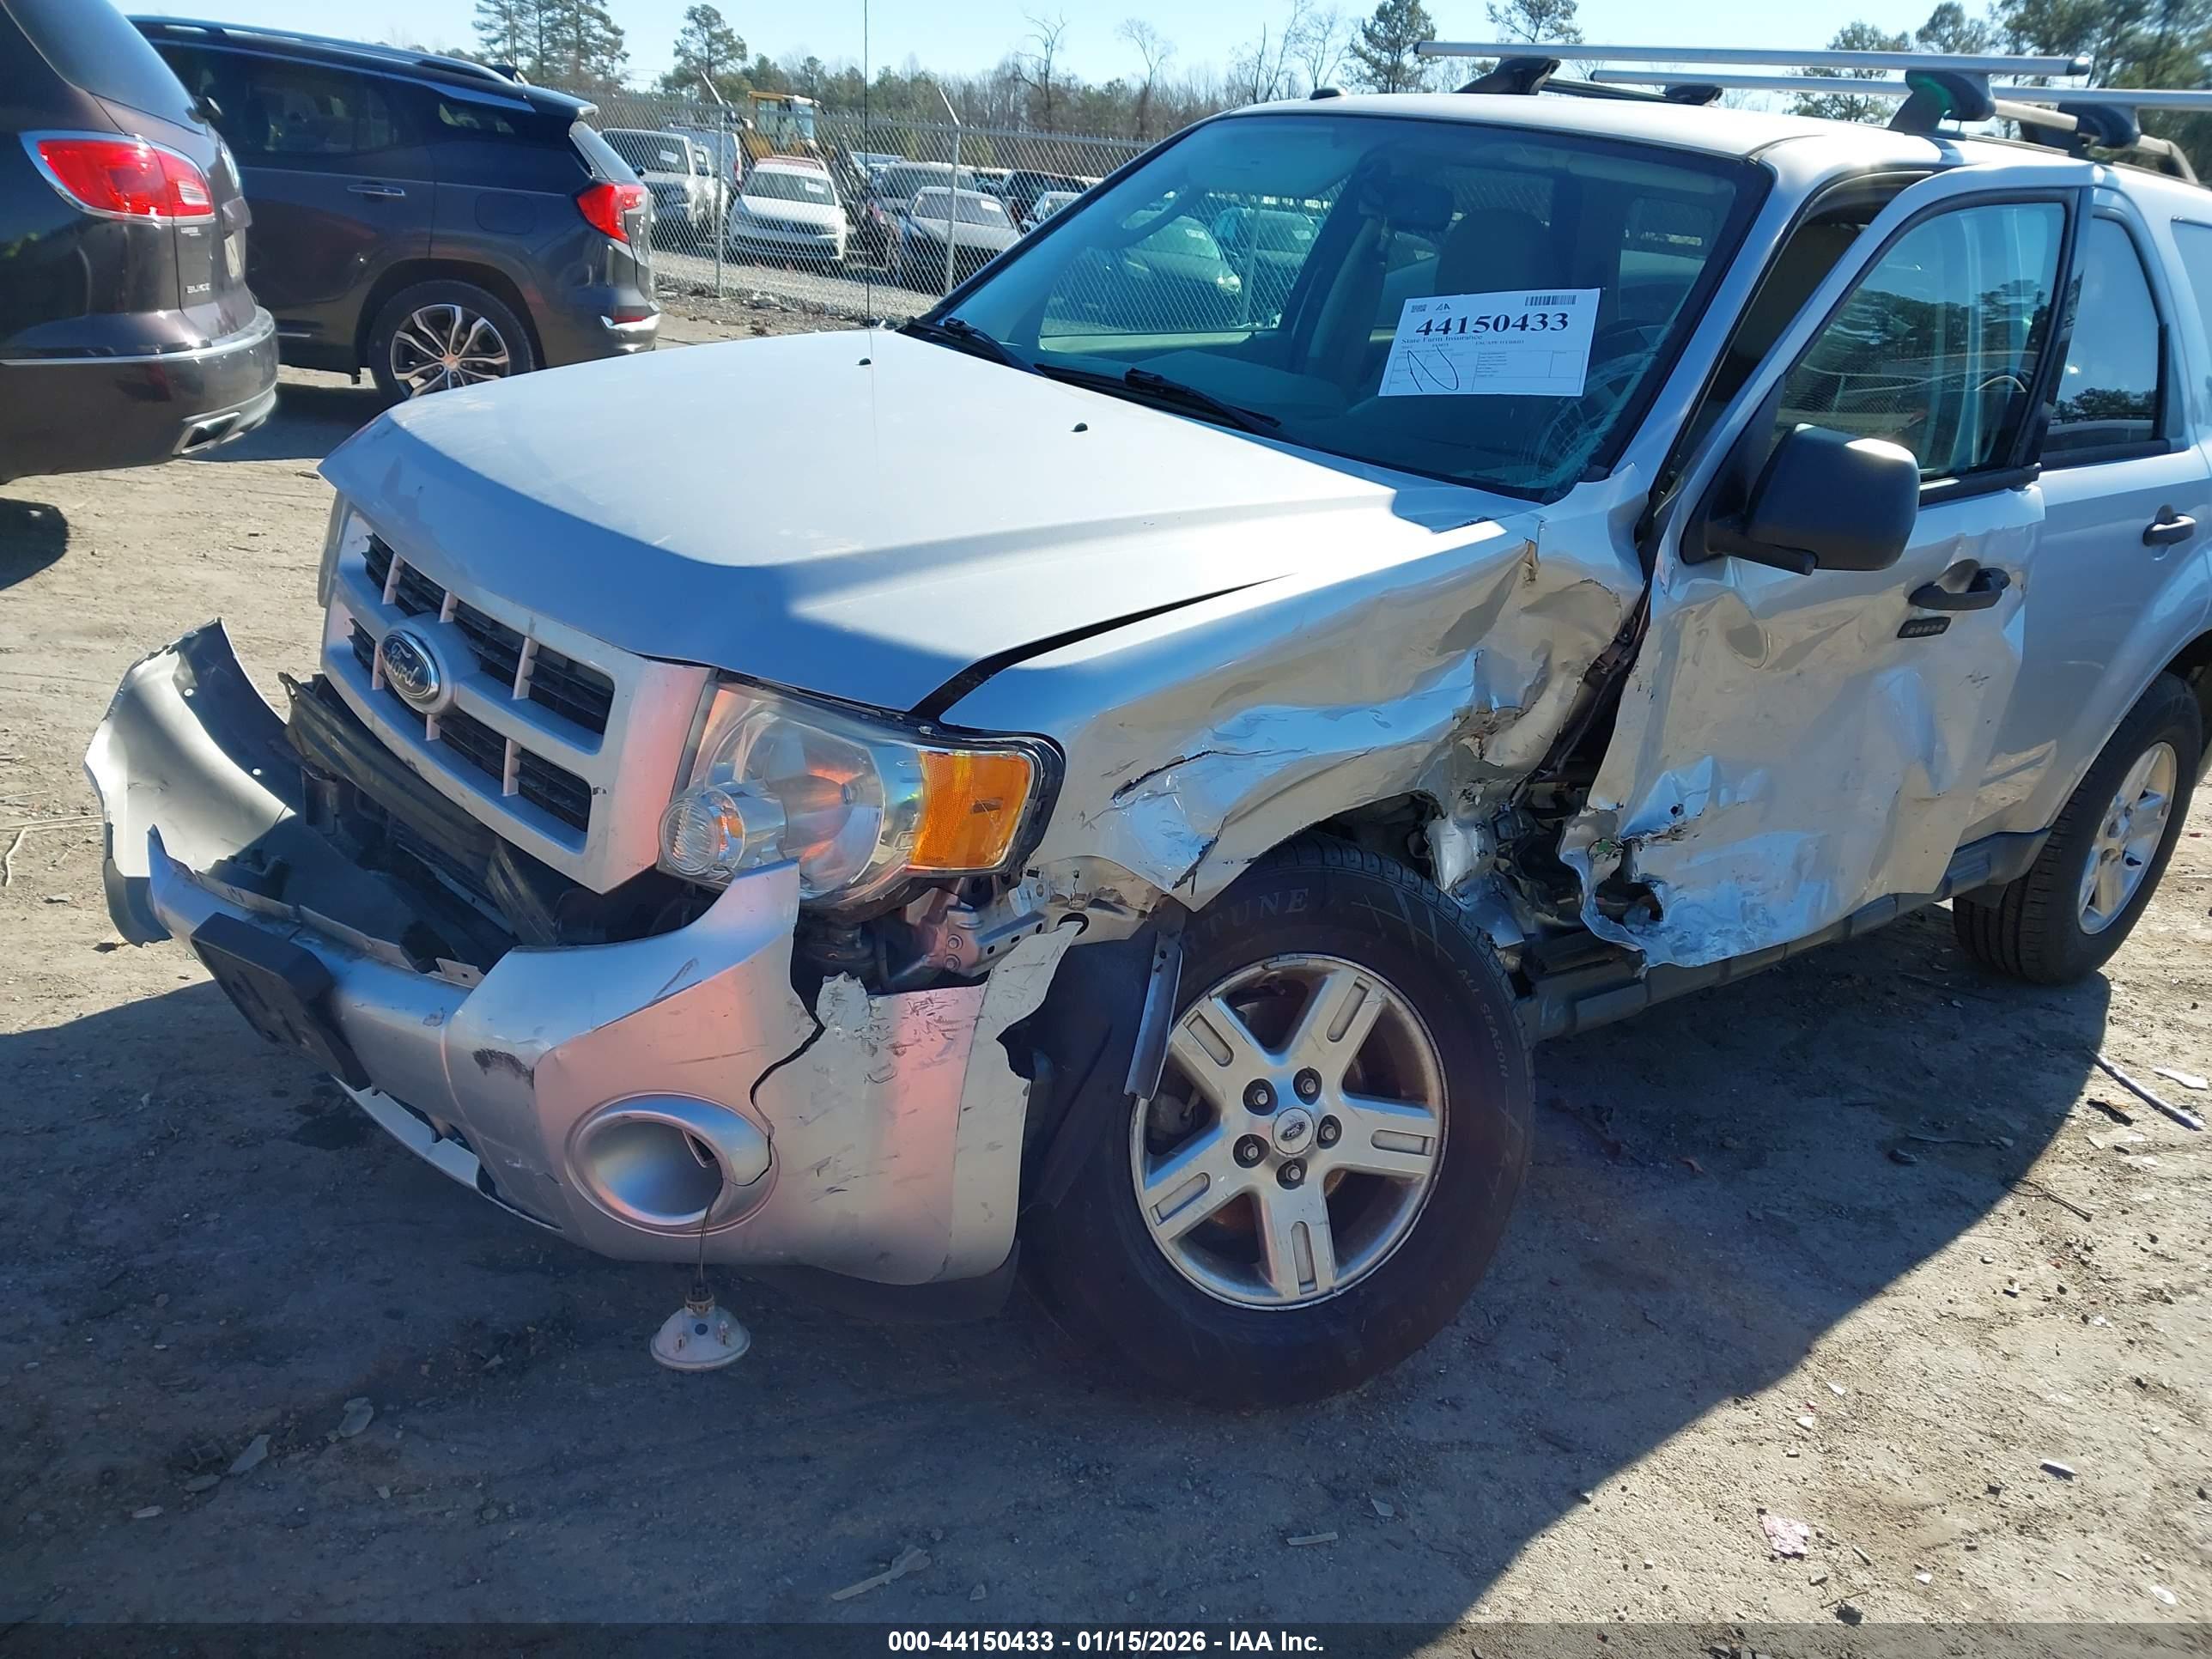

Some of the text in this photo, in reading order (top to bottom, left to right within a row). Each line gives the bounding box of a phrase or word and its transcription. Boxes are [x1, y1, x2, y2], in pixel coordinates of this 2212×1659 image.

[1415, 313, 1569, 336] 44150433
[386, 641, 419, 688] Ford
[1456, 969, 1510, 1079] ALL SEASON
